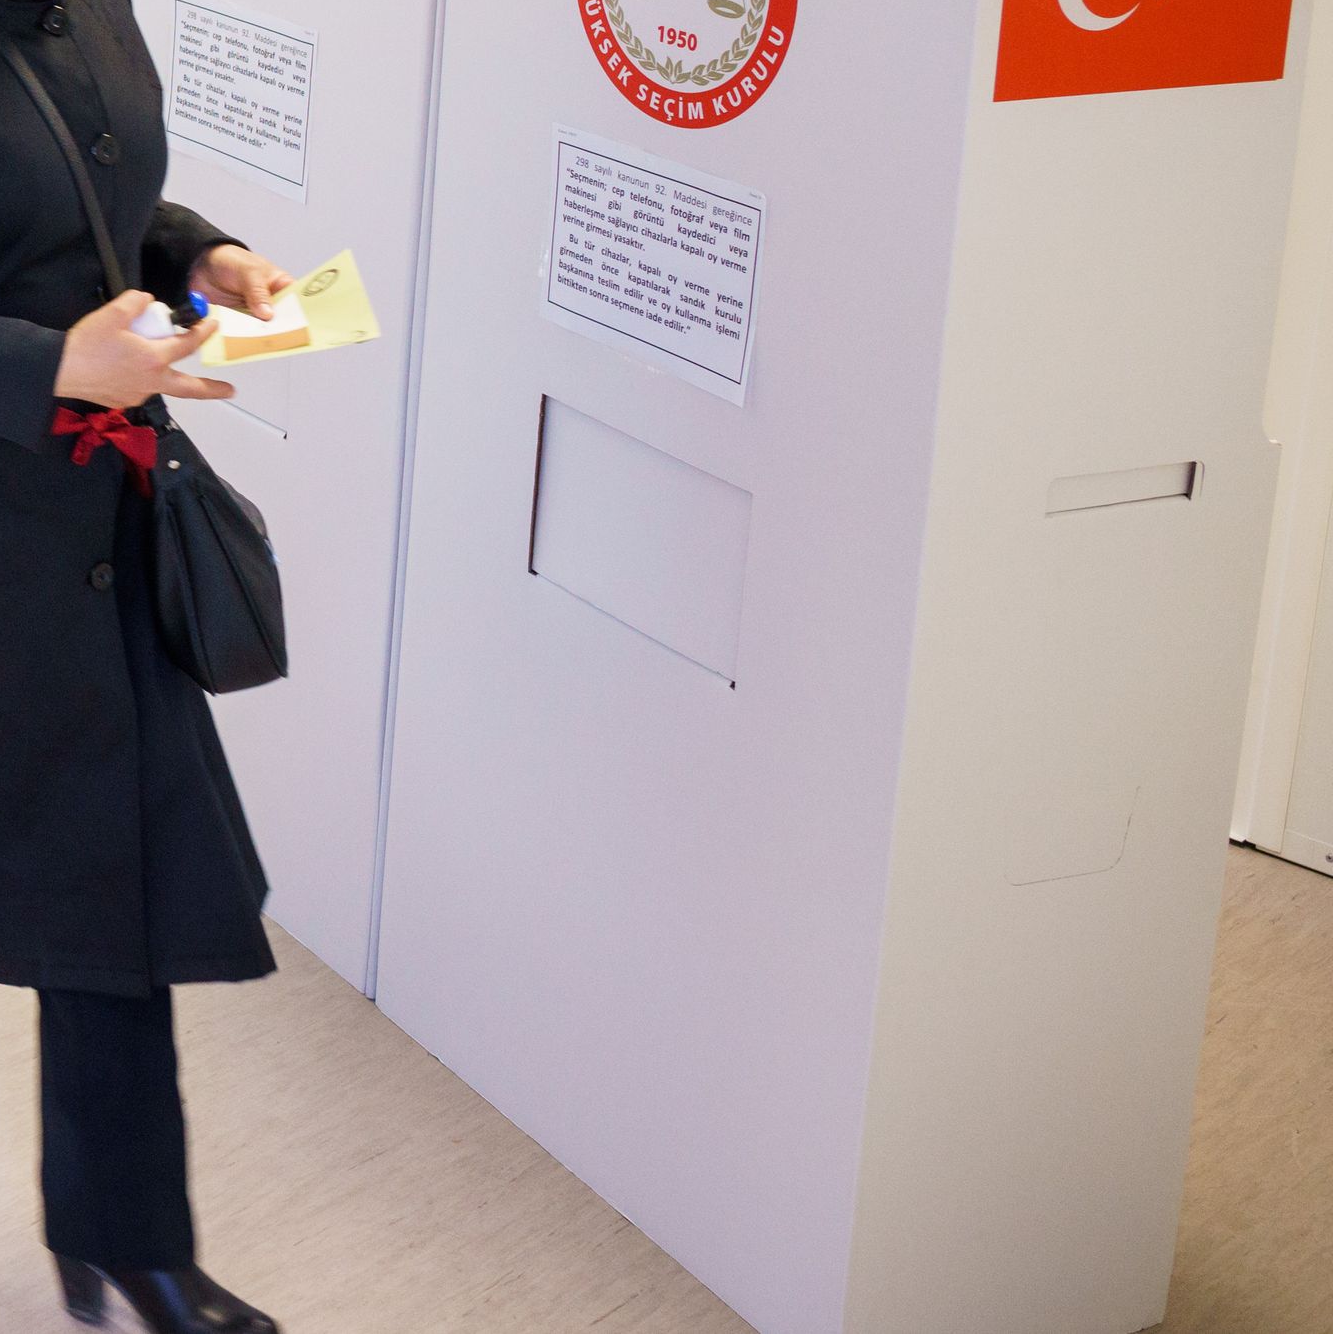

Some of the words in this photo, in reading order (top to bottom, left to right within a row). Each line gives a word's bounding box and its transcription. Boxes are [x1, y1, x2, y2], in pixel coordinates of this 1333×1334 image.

[636, 82, 704, 122] SEÇİM
[714, 25, 785, 116] KURULU
[657, 25, 698, 51] 1950
[565, 185, 597, 201] makinesi
[608, 200, 621, 211] gibi
[633, 210, 664, 226] görüntü
[678, 224, 716, 245] kaydedici
[729, 245, 748, 258] veya
[576, 156, 589, 169] 298
[594, 164, 612, 176] sayılı
[617, 171, 649, 189] kanunun
[673, 190, 707, 209] Maddesi
[712, 206, 752, 226] gereğince
[612, 186, 625, 198] cep
[630, 192, 664, 212] telefonu,
[671, 205, 704, 224] fotoğraf
[709, 221, 728, 233] veya
[734, 228, 750, 242] film
[563, 214, 585, 228] yerine
[586, 222, 612, 238] girmesi
[614, 234, 645, 251] yasaktır.
[564, 197, 605, 220] haberleşme
[608, 216, 638, 233] sağlayıcı
[641, 228, 677, 247] cihazlarla
[680, 240, 705, 257] kapalı
[707, 253, 718, 264] oy
[721, 258, 747, 273] verme
[557, 274, 588, 293] bittikten
[589, 289, 609, 303] sonra
[611, 298, 644, 316] seçmene
[646, 309, 662, 324] iade
[559, 246, 593, 265] girmeden
[601, 262, 619, 276] önce
[628, 272, 670, 296] kapatılarak
[680, 294, 705, 310] sandık
[715, 306, 742, 324] kurulu
[559, 259, 594, 281] başkanına
[598, 276, 620, 291] teslim
[624, 288, 644, 300] edilir
[648, 297, 657, 306] ve
[661, 302, 671, 313] oy
[675, 306, 711, 328] kullanma
[716, 322, 740, 340] işlemi
[569, 234, 579, 245] Bu
[584, 240, 595, 251] tür
[601, 247, 631, 266] cihazlar,
[638, 260, 661, 276] kapalı
[668, 274, 678, 285] oy
[684, 281, 710, 296] verme
[717, 293, 743, 309] yerine
